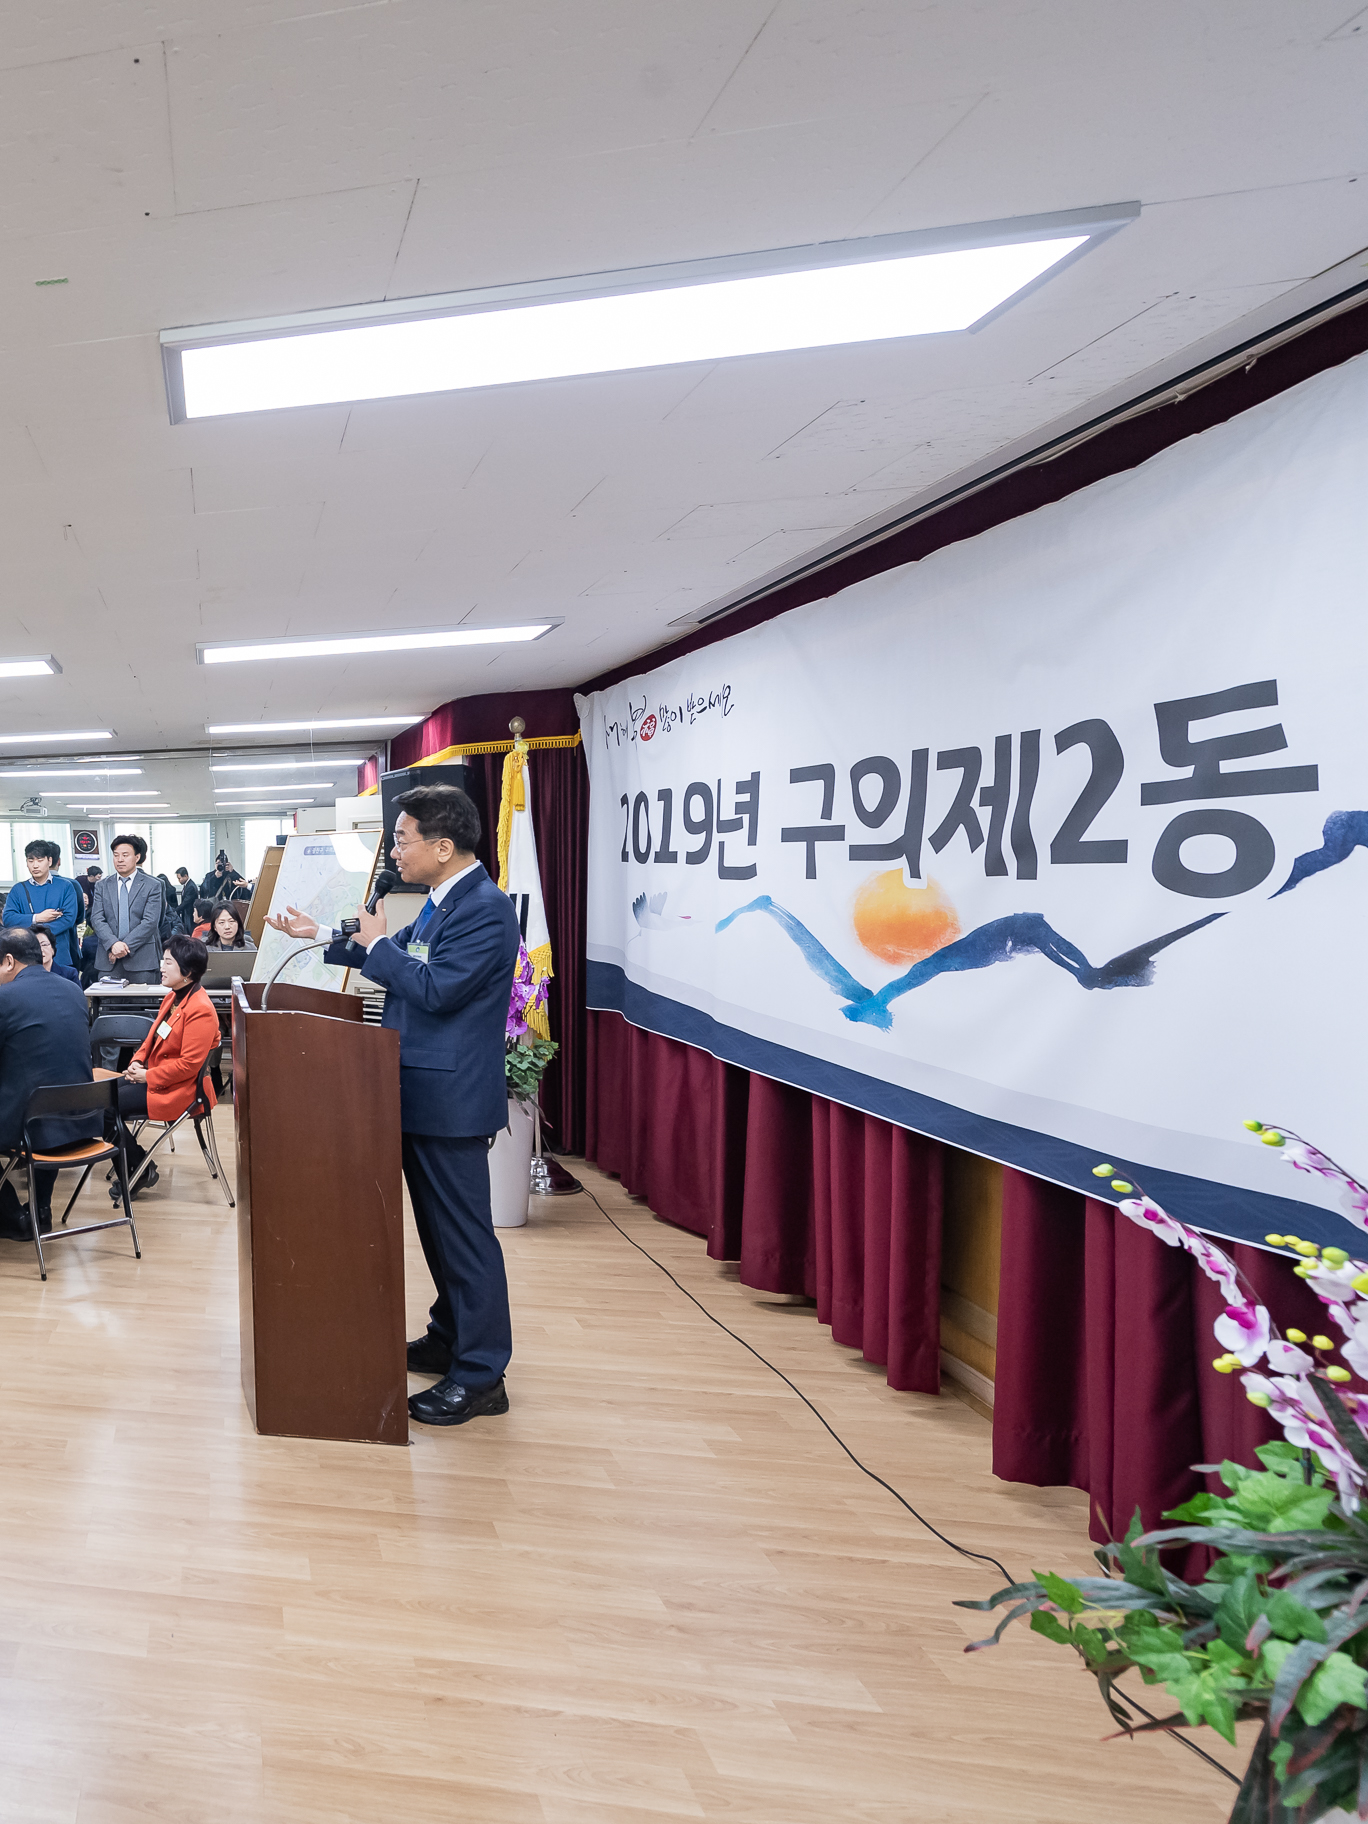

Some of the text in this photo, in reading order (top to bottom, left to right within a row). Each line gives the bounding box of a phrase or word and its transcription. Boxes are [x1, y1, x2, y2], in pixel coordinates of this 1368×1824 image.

[658, 703, 683, 733] 많이
[686, 683, 735, 725] 받으세요
[619, 678, 1320, 899] 2019년 구의제2동
